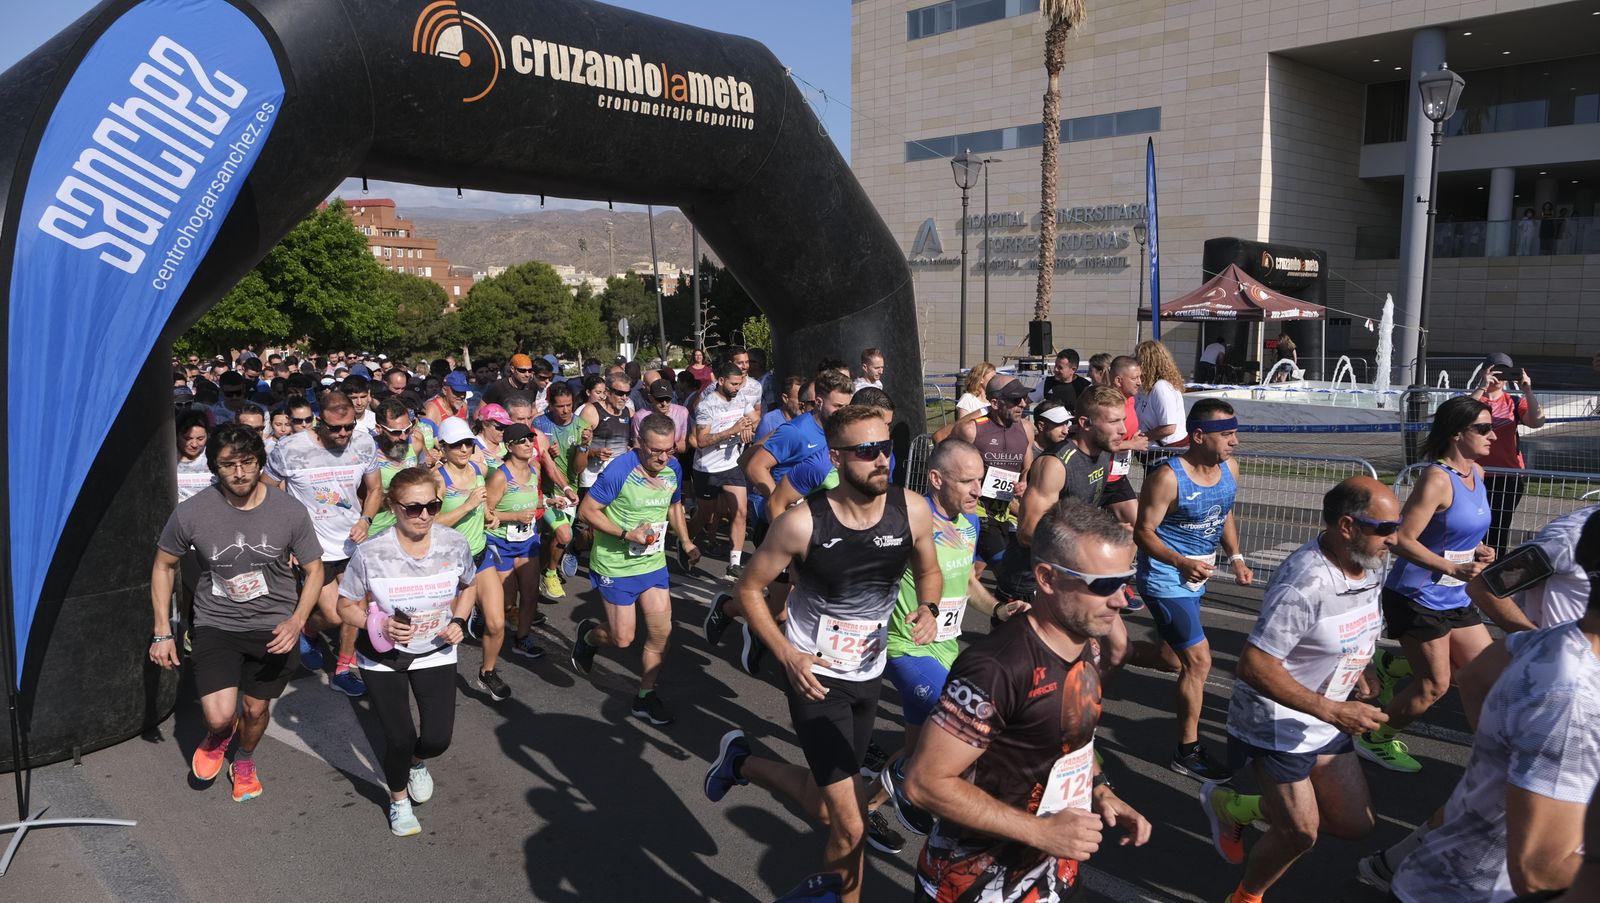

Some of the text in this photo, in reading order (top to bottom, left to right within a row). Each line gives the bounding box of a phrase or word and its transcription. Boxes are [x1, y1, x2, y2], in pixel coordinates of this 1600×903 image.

[511, 34, 755, 114] cruzandolameta
[598, 94, 755, 131] cronometraje deportivo
[152, 101, 276, 291] centrohogarsanchez.es
[986, 232, 1130, 251] TORRERDENAS
[992, 478, 1014, 491] 205
[226, 579, 261, 594] 132
[944, 611, 960, 627] 21
[829, 634, 882, 655] 1254
